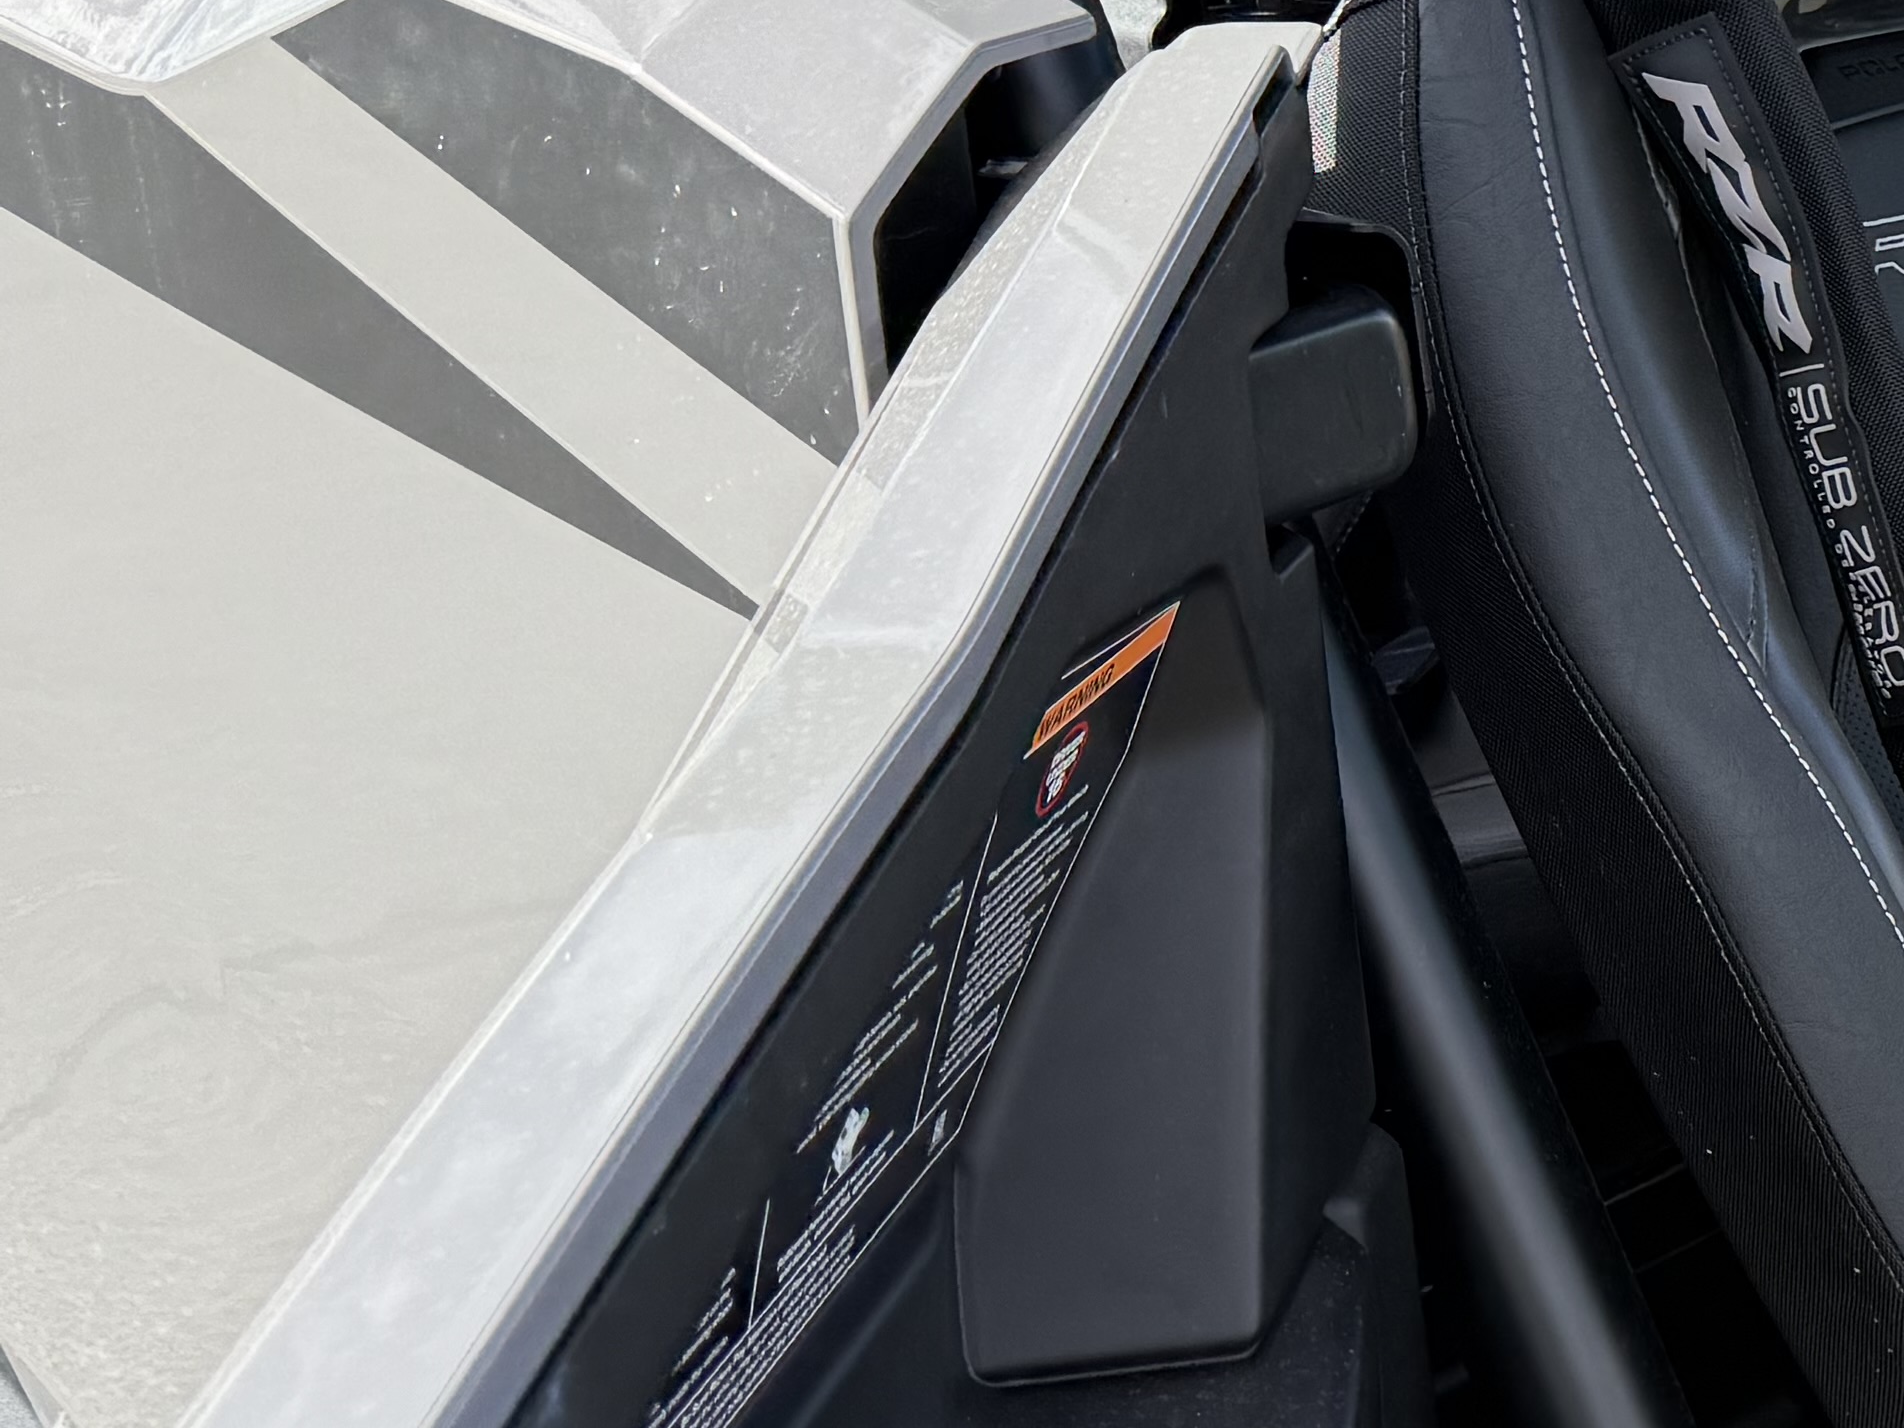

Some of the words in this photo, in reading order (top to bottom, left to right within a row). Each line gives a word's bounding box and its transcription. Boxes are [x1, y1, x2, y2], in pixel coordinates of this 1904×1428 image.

[1641, 72, 1814, 356] RZR
[1796, 382, 1859, 511] SUB
[1786, 386, 1836, 530] CONTROLLED
